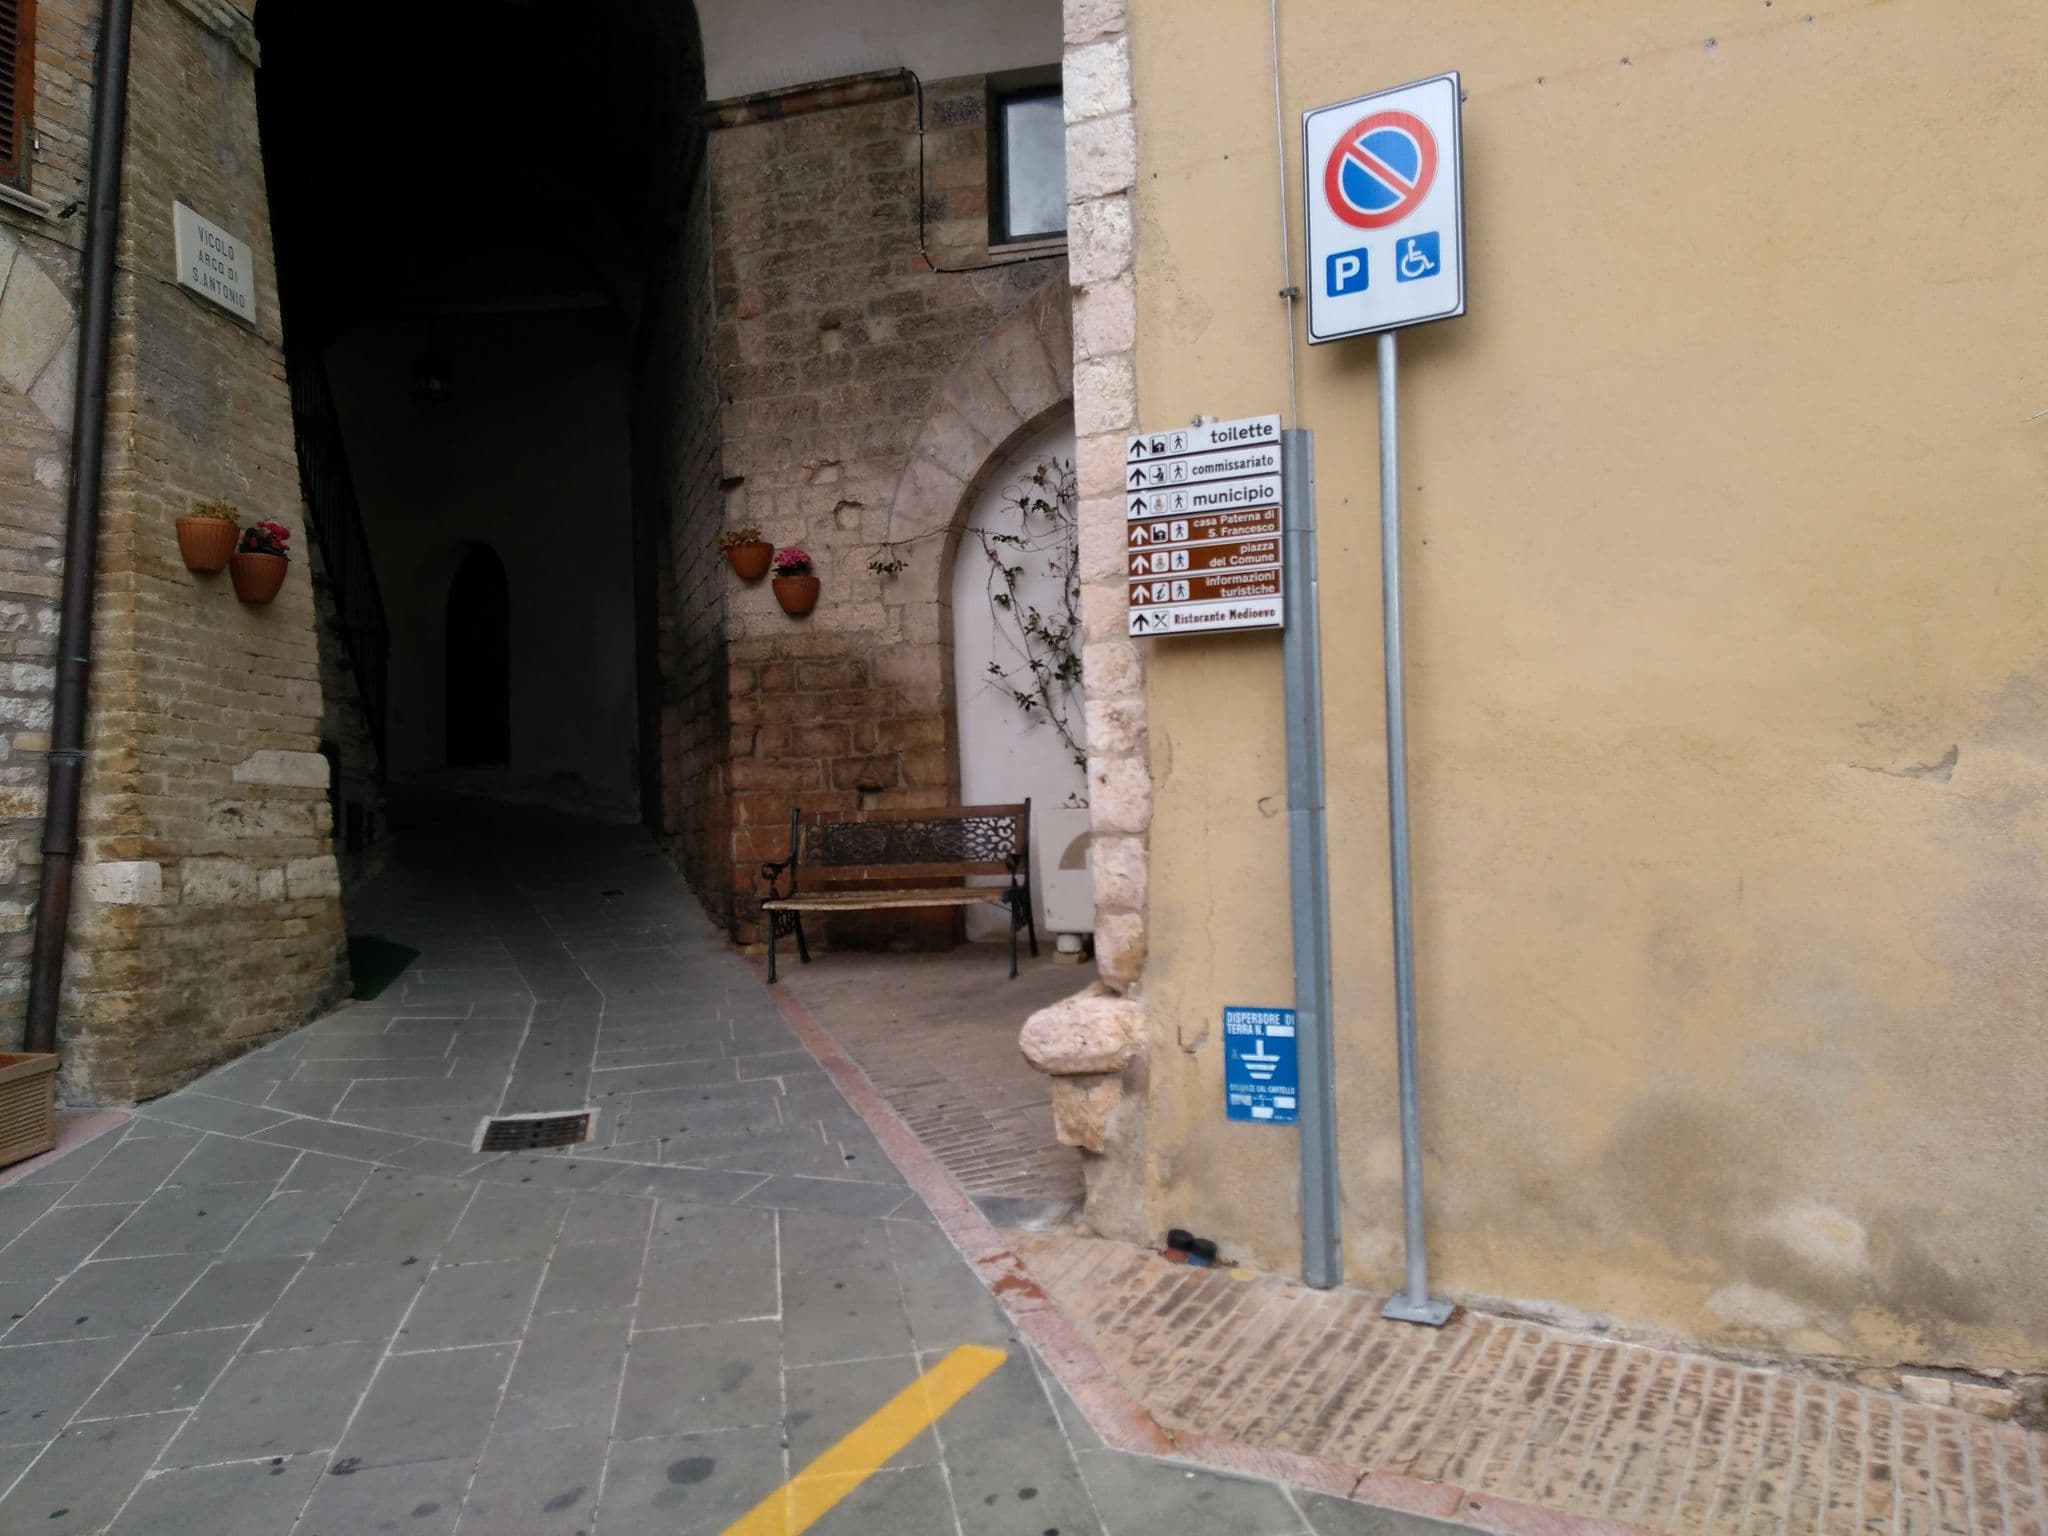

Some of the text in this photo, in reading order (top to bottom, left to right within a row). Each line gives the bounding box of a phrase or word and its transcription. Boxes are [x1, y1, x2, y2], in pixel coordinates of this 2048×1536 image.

[198, 226, 234, 260] VICOLO
[198, 250, 238, 283] ARCO DI
[1335, 255, 1360, 291] P
[1211, 424, 1273, 443] toilette
[1192, 453, 1274, 475] commissariato
[1193, 485, 1274, 506] municipio
[1193, 509, 1275, 528] casa Paterna di
[1207, 524, 1275, 538] S. Francesco
[1240, 543, 1274, 555] piazza
[1209, 552, 1275, 568] del Comune
[1205, 571, 1276, 587] informazioni
[1220, 584, 1275, 598] turistiche
[1174, 608, 1276, 625] Ristorante Medioevo
[1226, 1011, 1296, 1025] DISPERSORE DI
[1226, 1024, 1254, 1035] TERRA
